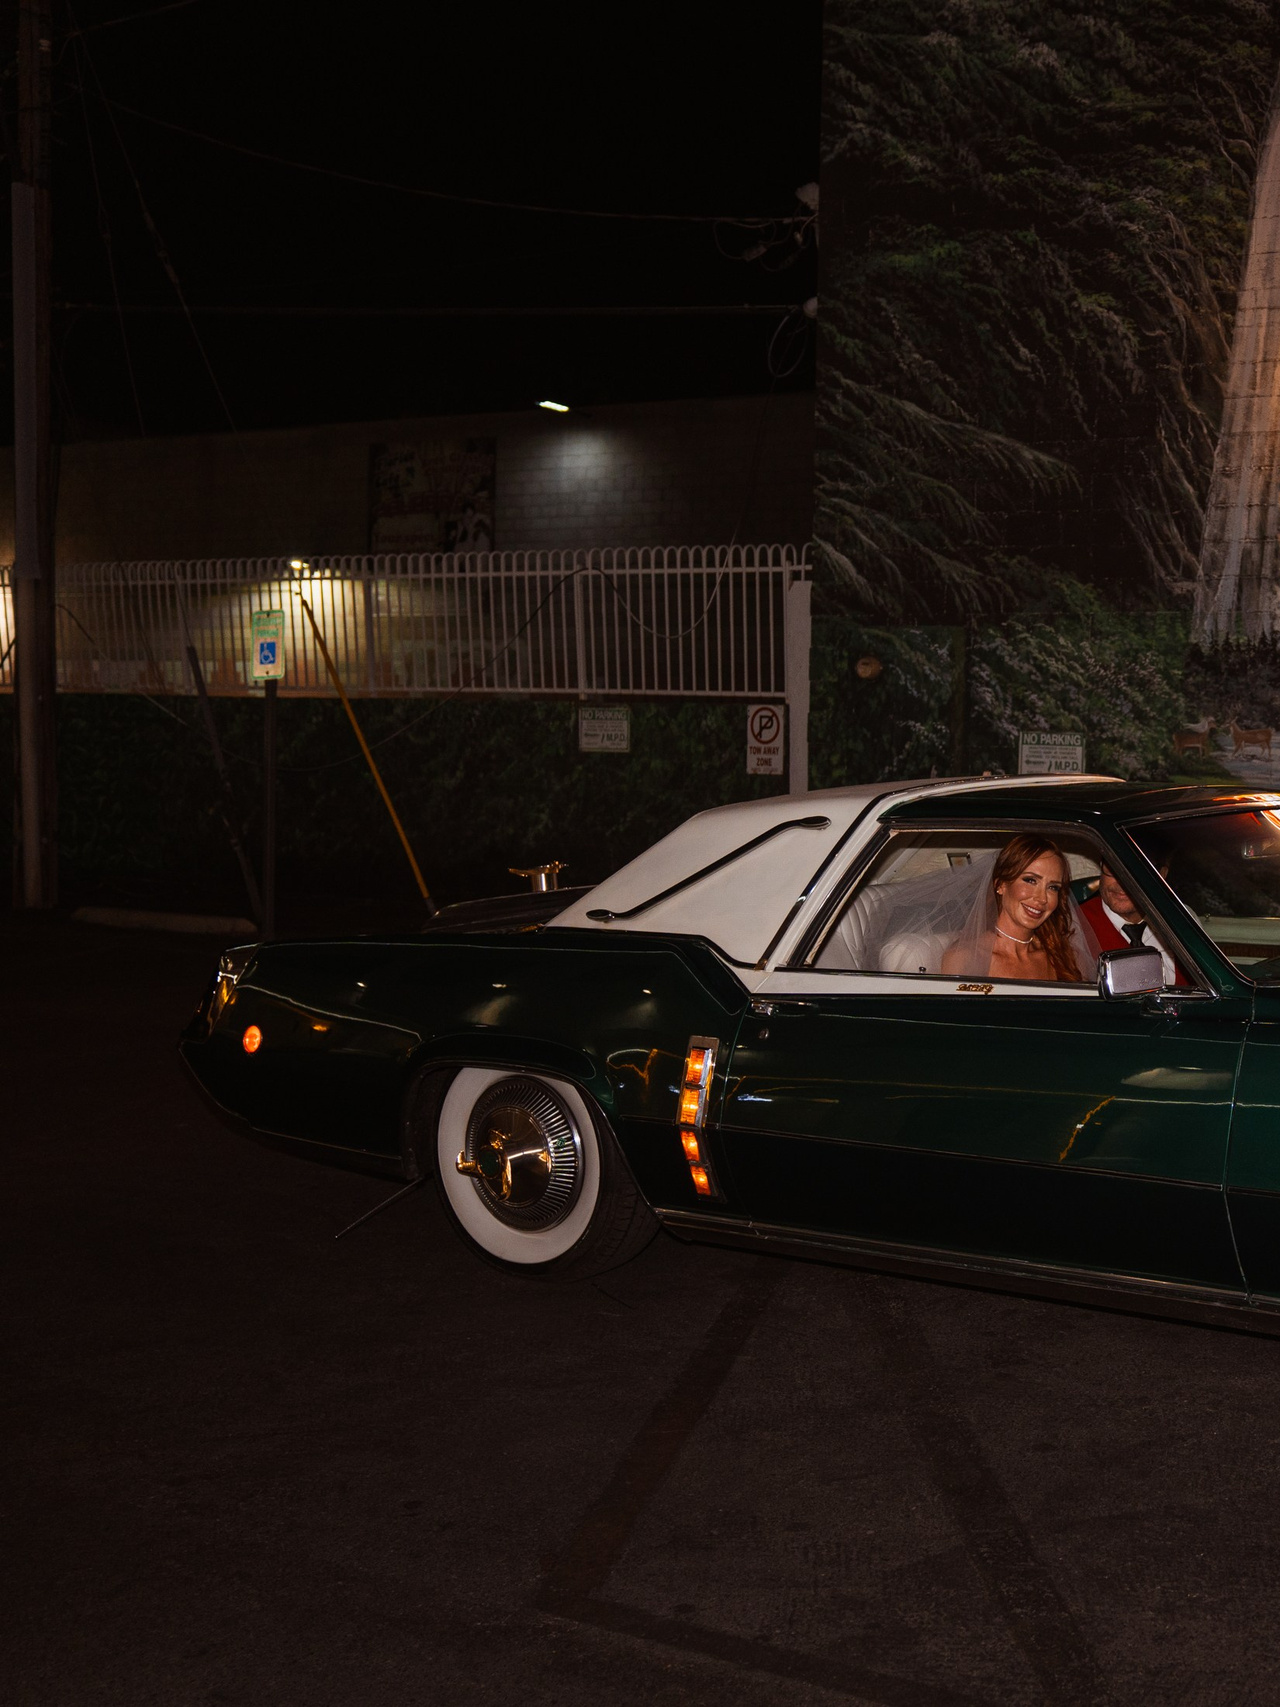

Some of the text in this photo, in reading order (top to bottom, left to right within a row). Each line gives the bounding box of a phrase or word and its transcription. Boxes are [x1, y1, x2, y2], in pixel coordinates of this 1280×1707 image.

[583, 710, 626, 720] NO PARKING
[1024, 734, 1081, 745] NO PARKING
[749, 746, 780, 755] TOW AWAY
[756, 757, 773, 767] ZONE
